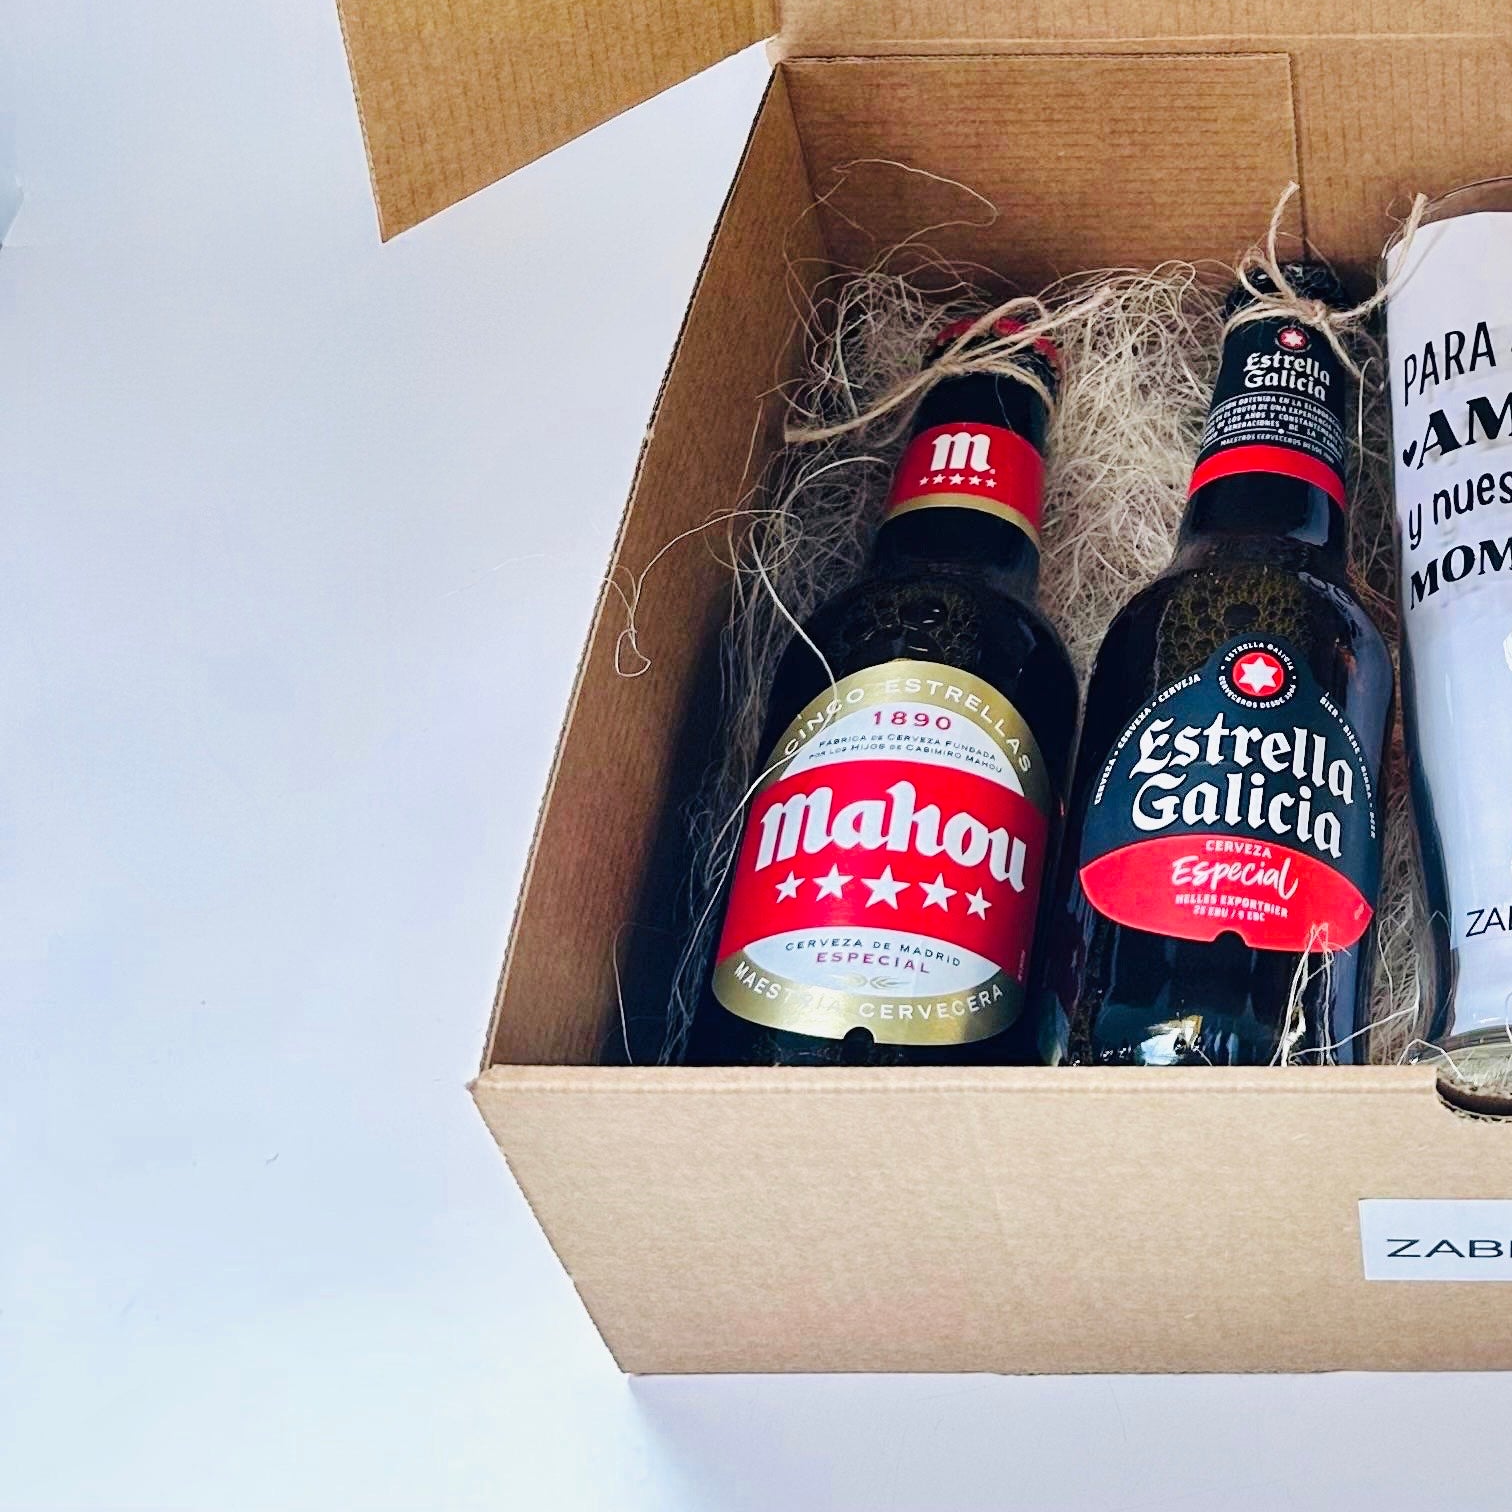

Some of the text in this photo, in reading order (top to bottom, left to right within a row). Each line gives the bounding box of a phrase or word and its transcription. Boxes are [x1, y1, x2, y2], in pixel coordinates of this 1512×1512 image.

[1243, 350, 1331, 387] Estrella
[1404, 321, 1497, 406] PARA
[1244, 369, 1326, 402] Galicia
[1408, 503, 1422, 550] y
[873, 711, 952, 731] 1890
[884, 677, 1033, 773] ESTRELLAS
[887, 733, 941, 747] CERVEZA
[945, 740, 997, 761] FUNDADA
[965, 755, 1003, 773] MAHOU
[1129, 712, 1354, 806] Estrella
[1132, 772, 1342, 859] Galicia
[1205, 839, 1273, 860] CERVEZA
[1171, 854, 1299, 901] Especial
[785, 938, 962, 968] CERVEZA DE MADRID
[816, 951, 930, 974] ESPECIAL
[858, 984, 1003, 1020] CERVECERA
